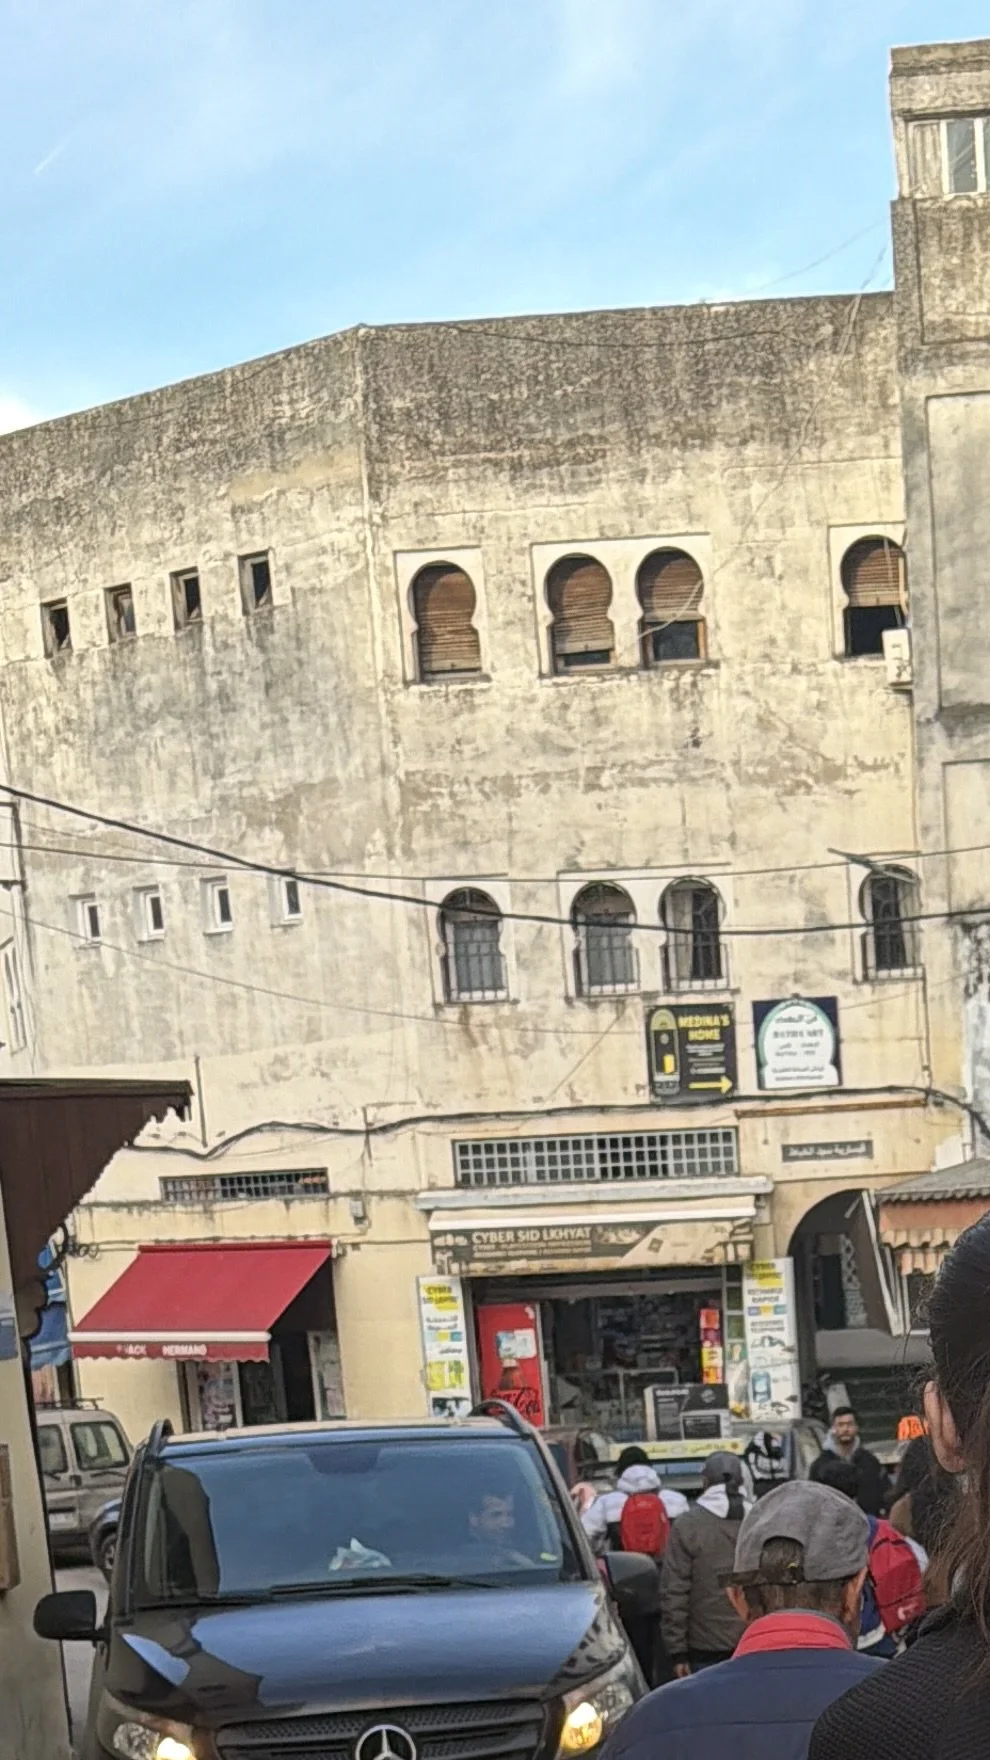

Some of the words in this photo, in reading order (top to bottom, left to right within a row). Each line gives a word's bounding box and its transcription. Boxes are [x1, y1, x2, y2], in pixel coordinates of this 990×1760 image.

[688, 1028, 721, 1041] HOME
[472, 1231, 515, 1244] CYBER
[517, 1228, 541, 1242] SID
[543, 1227, 592, 1241] LKHYAT
